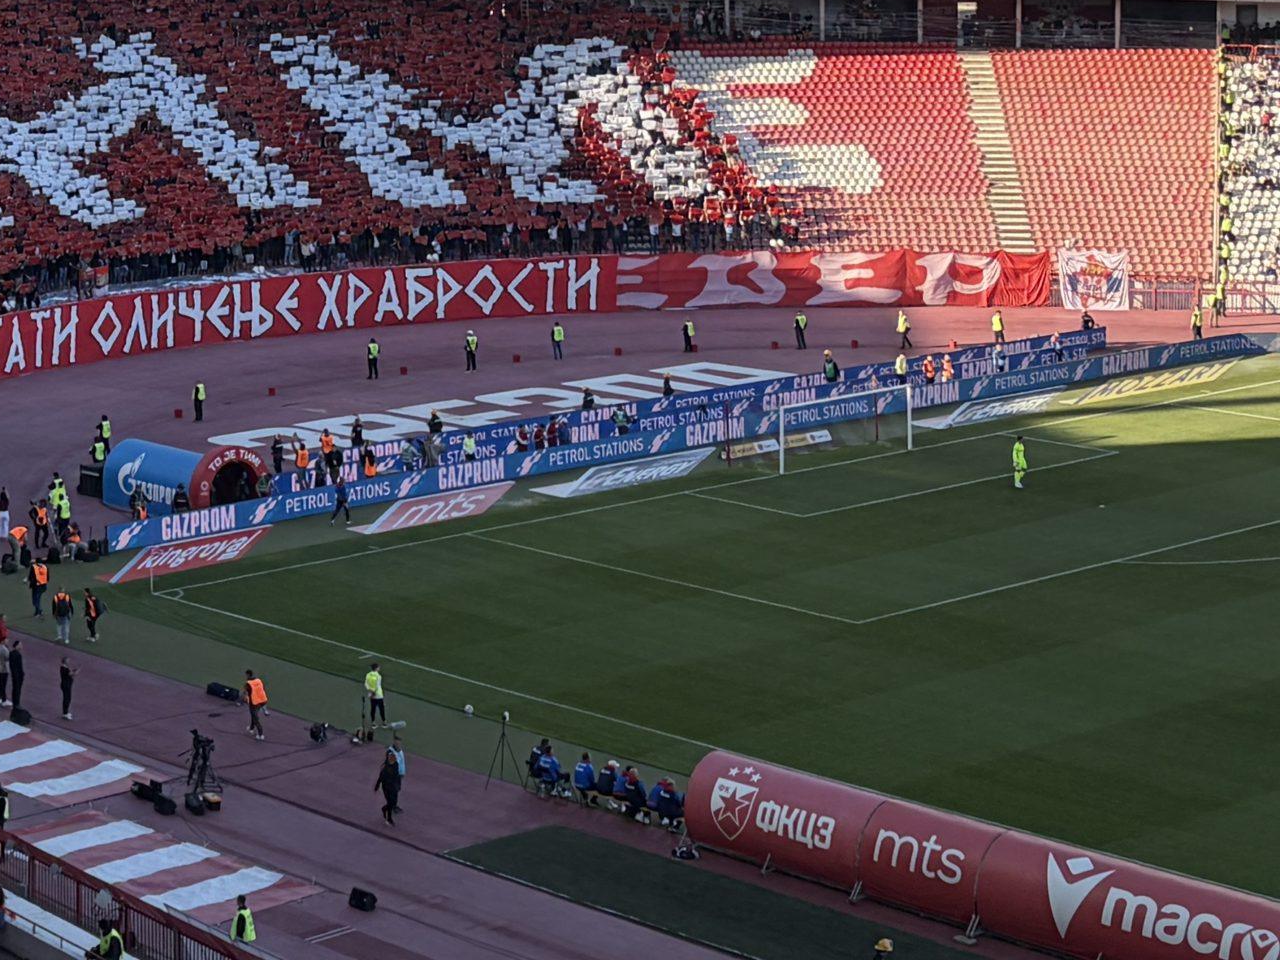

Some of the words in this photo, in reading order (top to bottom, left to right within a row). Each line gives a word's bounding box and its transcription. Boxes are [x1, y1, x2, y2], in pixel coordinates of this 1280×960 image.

[91, 278, 301, 355] ОЛИЧЕЊЕ
[318, 258, 601, 330] ХРАБРОСТИ
[1102, 350, 1150, 376] GAZPROM
[1179, 343, 1210, 358] PETROL
[995, 375, 1028, 391] PETROL
[1030, 367, 1069, 385] STATIONS
[640, 415, 677, 432] PETROL
[784, 408, 822, 425] PETROL
[823, 401, 869, 419] STATIONS
[549, 447, 591, 466] PETROL
[593, 438, 644, 459] STATIONS
[438, 456, 505, 490] GAZPROM
[285, 492, 332, 514] PETROL
[344, 481, 391, 503] ATIONS
[161, 504, 236, 540] GAZPROM
[755, 800, 836, 850] ФКЦЗ
[873, 828, 966, 885] mts
